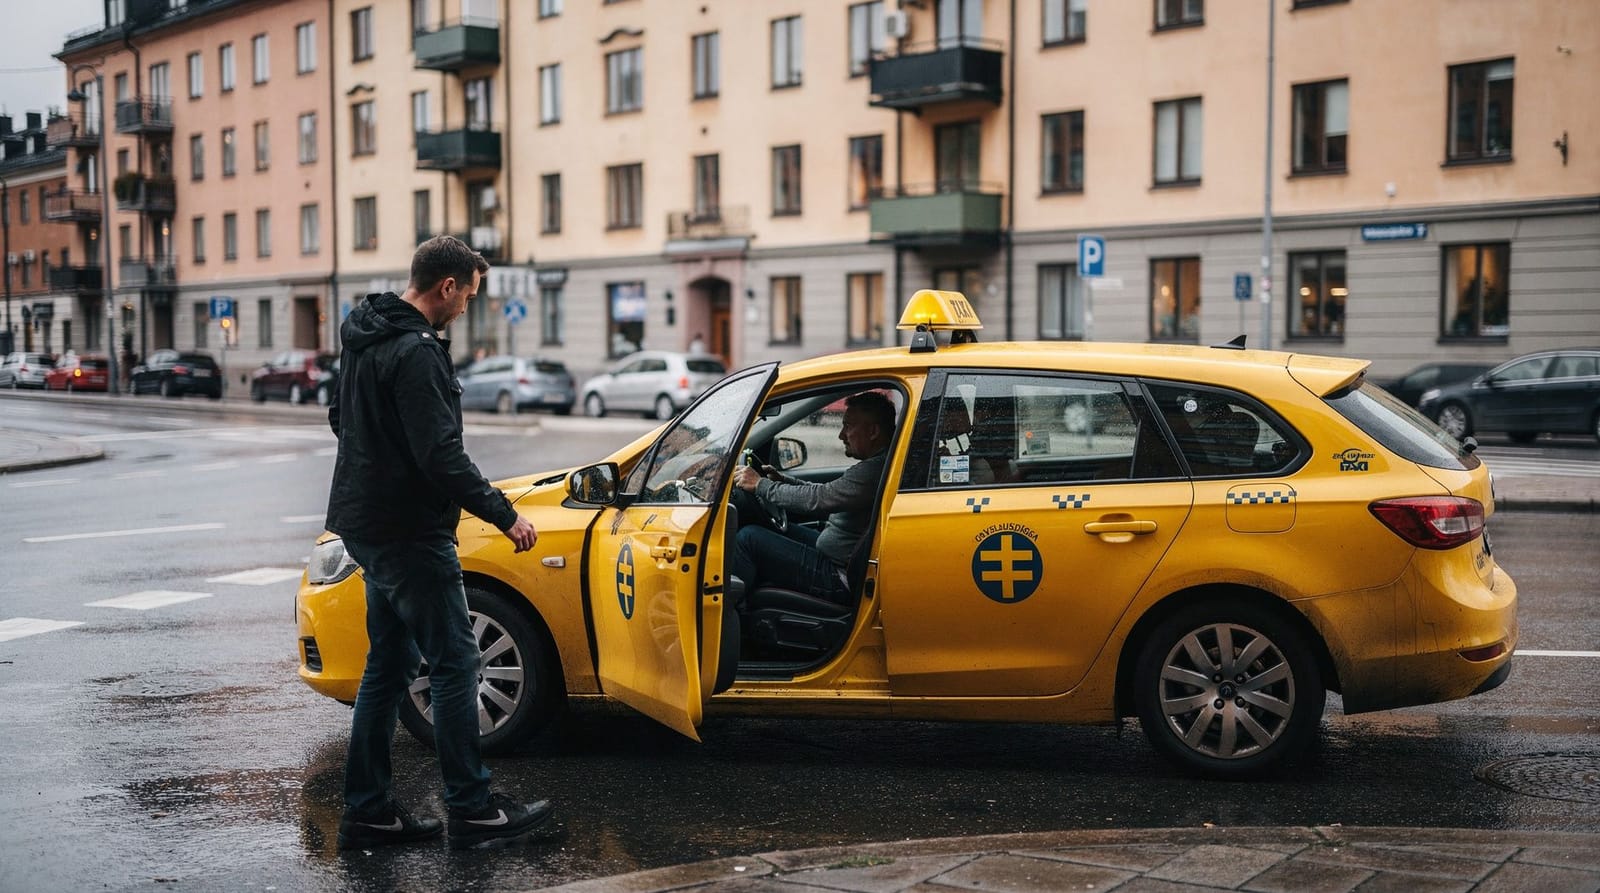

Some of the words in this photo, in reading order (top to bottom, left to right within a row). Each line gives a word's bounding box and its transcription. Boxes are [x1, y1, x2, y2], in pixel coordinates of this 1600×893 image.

[1083, 239, 1102, 274] P
[215, 297, 228, 318] P
[1340, 461, 1368, 471] TAXI
